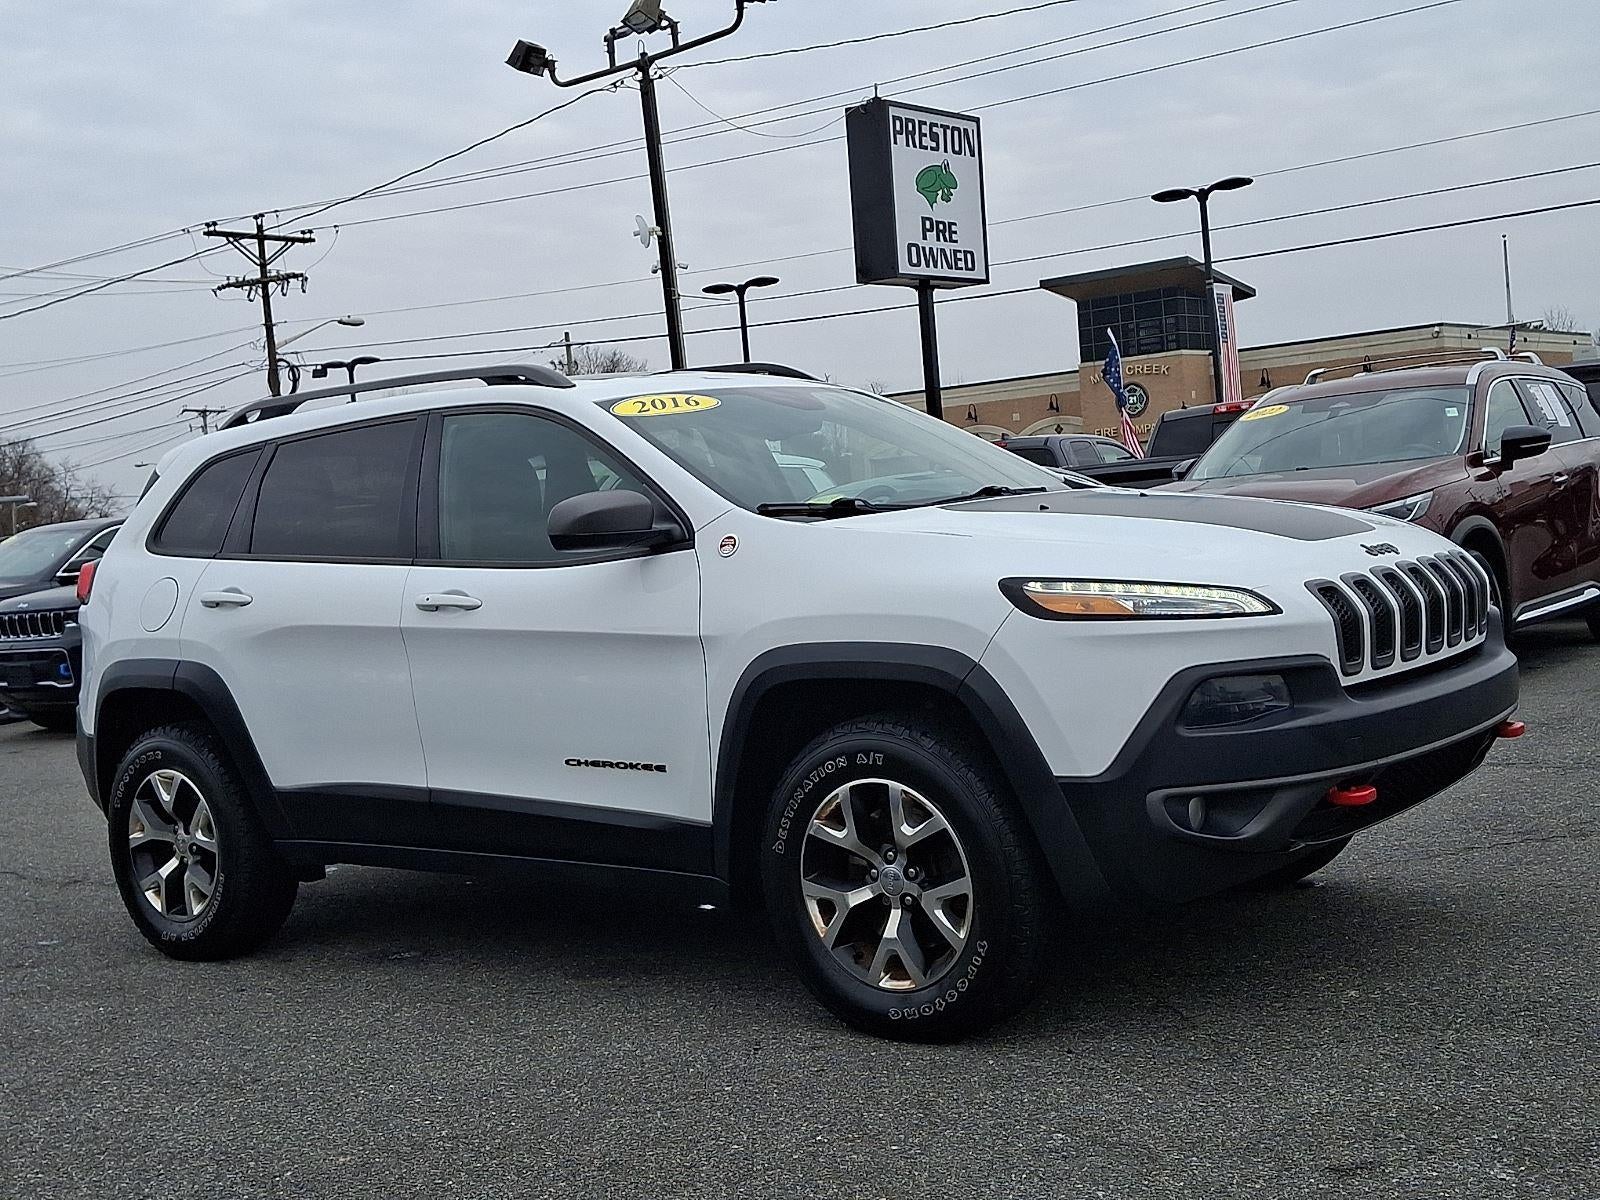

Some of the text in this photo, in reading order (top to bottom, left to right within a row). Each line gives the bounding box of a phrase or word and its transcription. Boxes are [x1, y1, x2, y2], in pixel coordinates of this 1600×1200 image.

[892, 115, 975, 157] PRESTON
[921, 216, 958, 243] PRE
[907, 243, 975, 271] OWNED
[1126, 363, 1169, 375] CREEK
[633, 396, 700, 414] 2016
[1094, 426, 1118, 438] FIRE
[564, 758, 667, 773] CHEROKEE
[772, 752, 885, 855] DESTINATION A/T
[888, 939, 988, 1020] Firestone
